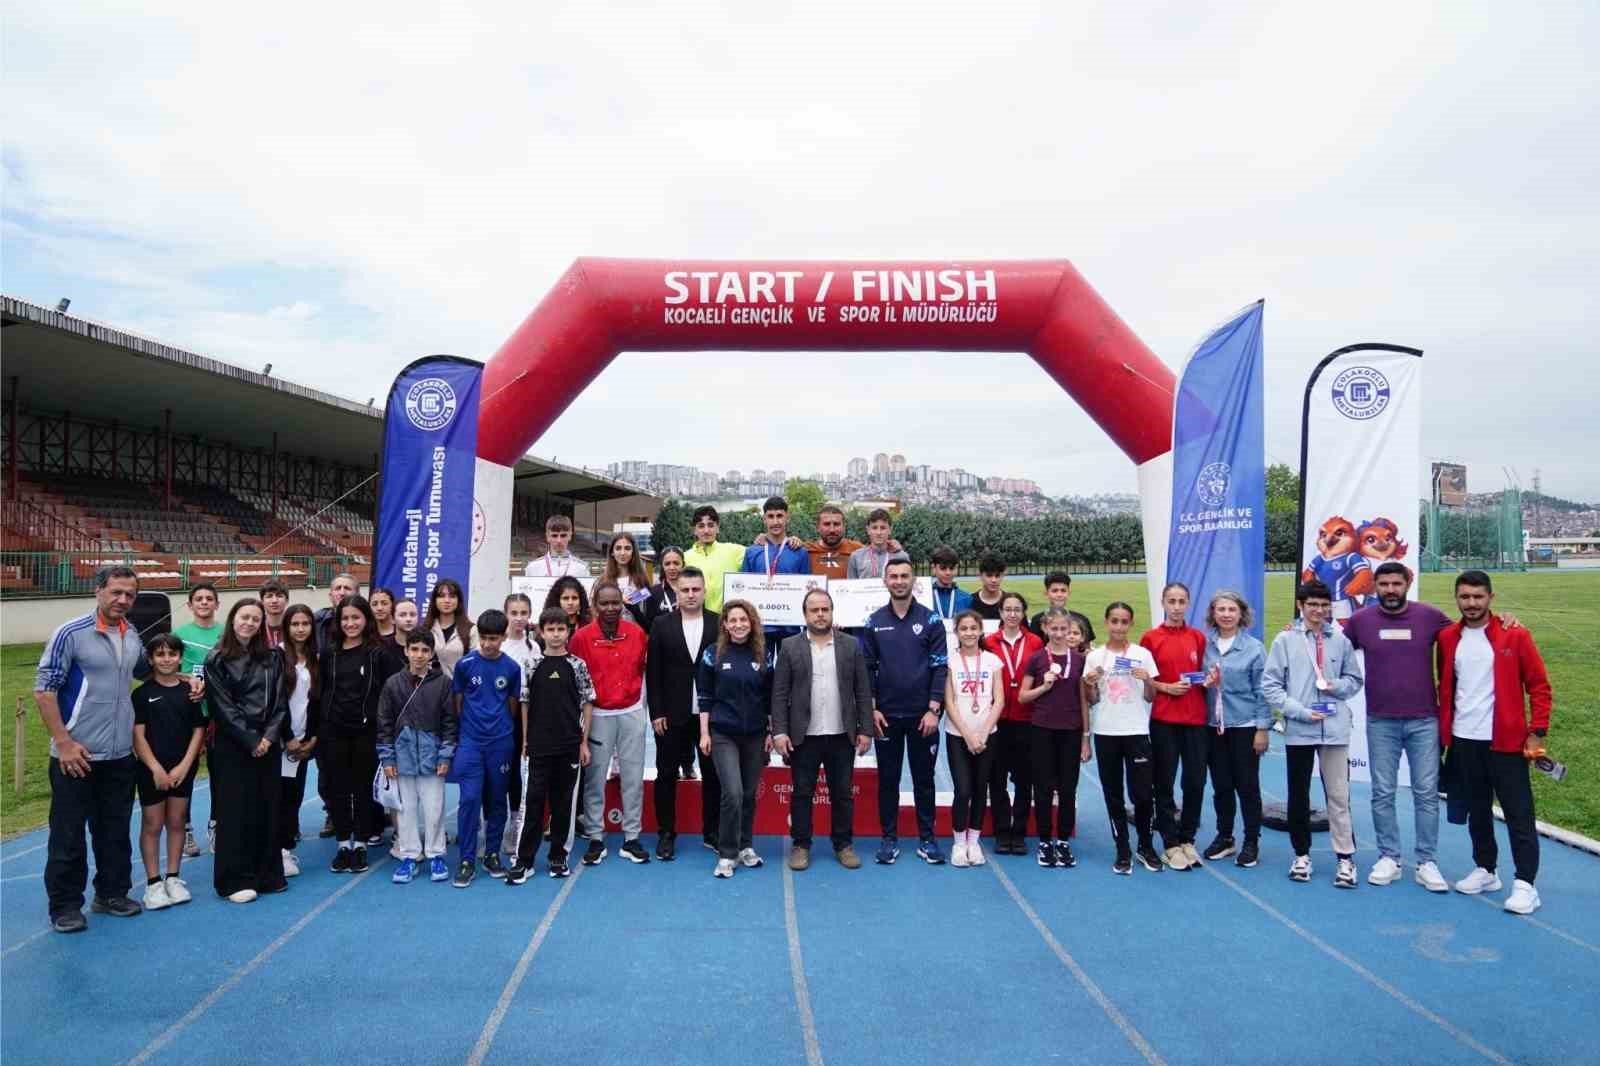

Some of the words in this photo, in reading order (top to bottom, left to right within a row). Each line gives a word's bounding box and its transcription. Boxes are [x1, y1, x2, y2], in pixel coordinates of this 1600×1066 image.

[664, 271, 804, 304] START
[815, 271, 835, 302] /
[852, 270, 997, 302] FINISH
[664, 304, 727, 324] KOCAELİ
[731, 304, 793, 327] GENÇLİK
[808, 307, 826, 322] VE
[839, 306, 880, 322] SPOR
[884, 303, 897, 322] İL
[902, 303, 997, 322] MÜDÜRLÜĞÜ
[1238, 507, 1253, 518] VE
[424, 530, 442, 568] Spor
